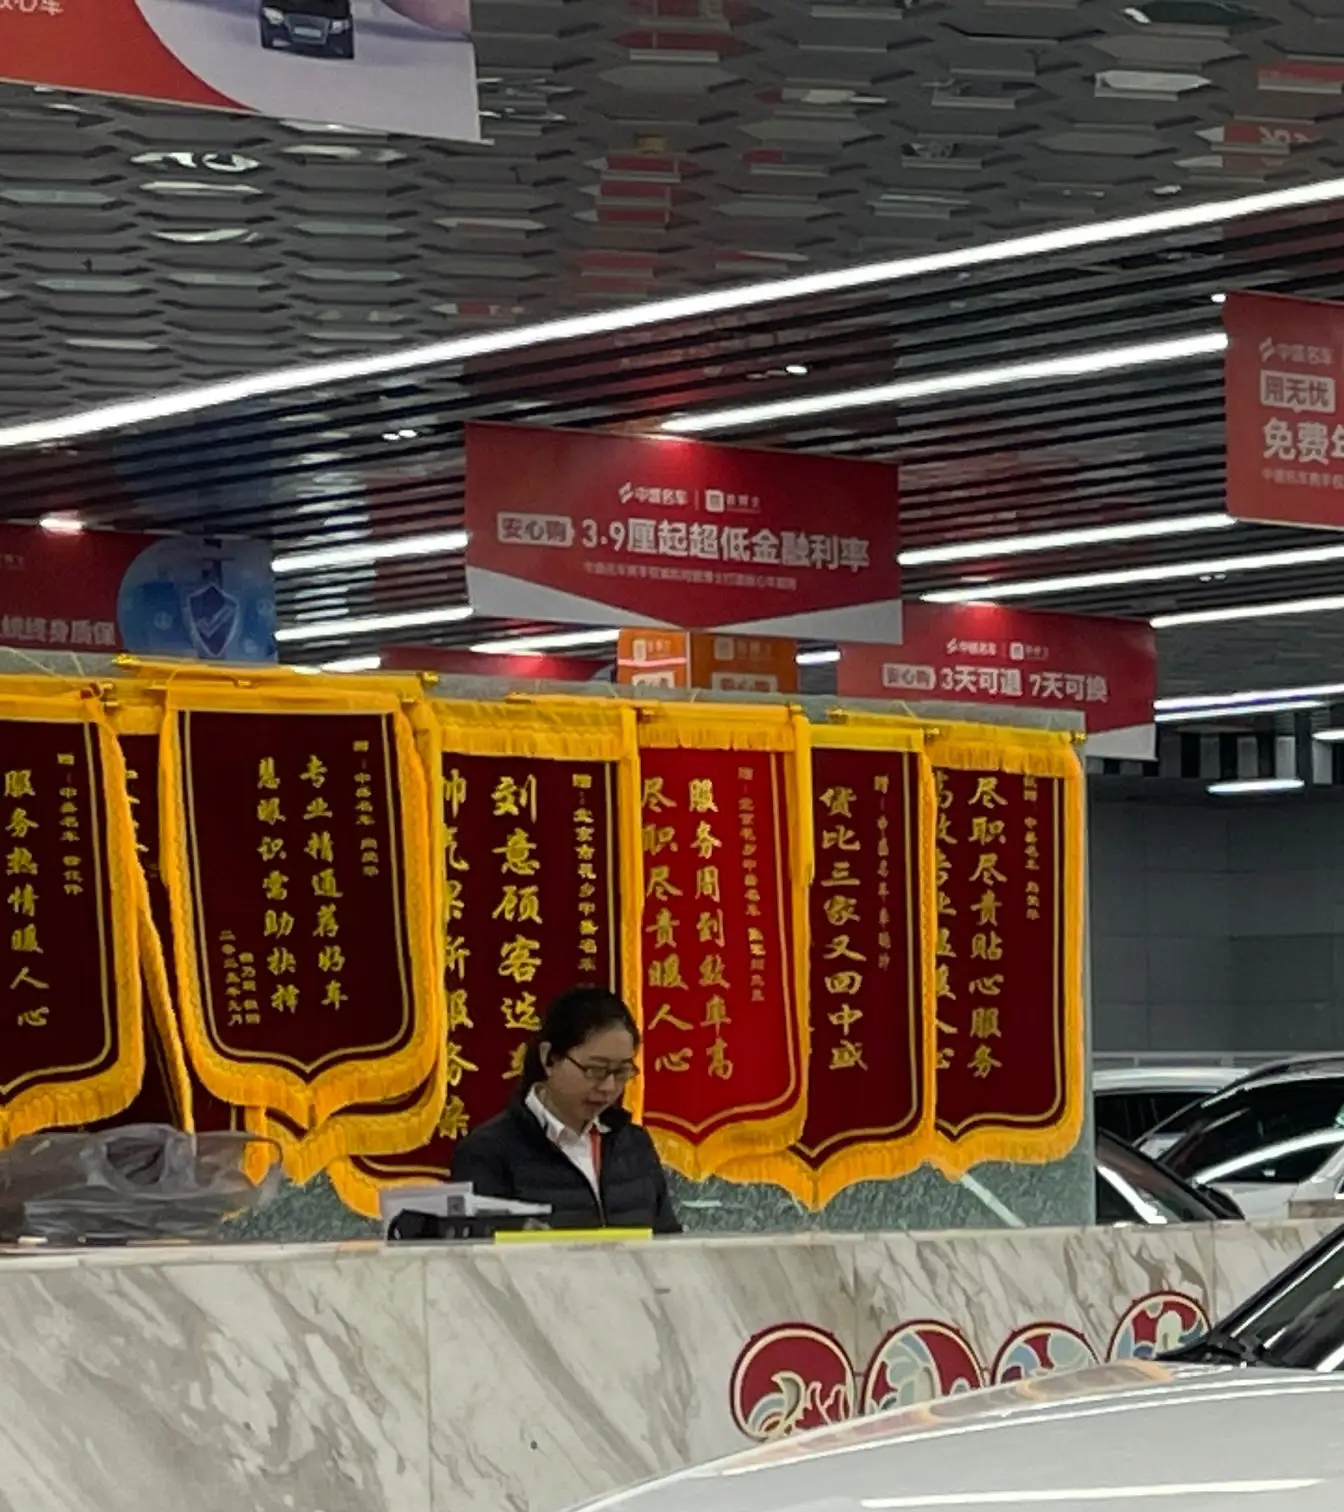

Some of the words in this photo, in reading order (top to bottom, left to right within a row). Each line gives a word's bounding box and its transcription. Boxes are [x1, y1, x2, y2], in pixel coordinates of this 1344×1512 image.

[1265, 375, 1331, 408] 用无忧
[581, 516, 871, 573] 3.9厘起超低金融利率
[940, 665, 1023, 697] 3天可退
[1029, 671, 1110, 703] 7天可换
[4, 770, 49, 1028] 服务热情暖人心
[640, 777, 694, 1074] 尽职尽责暖人心
[687, 778, 734, 1080] 服务周到效率高
[967, 777, 1008, 1080] 尽职尽责贴心服务
